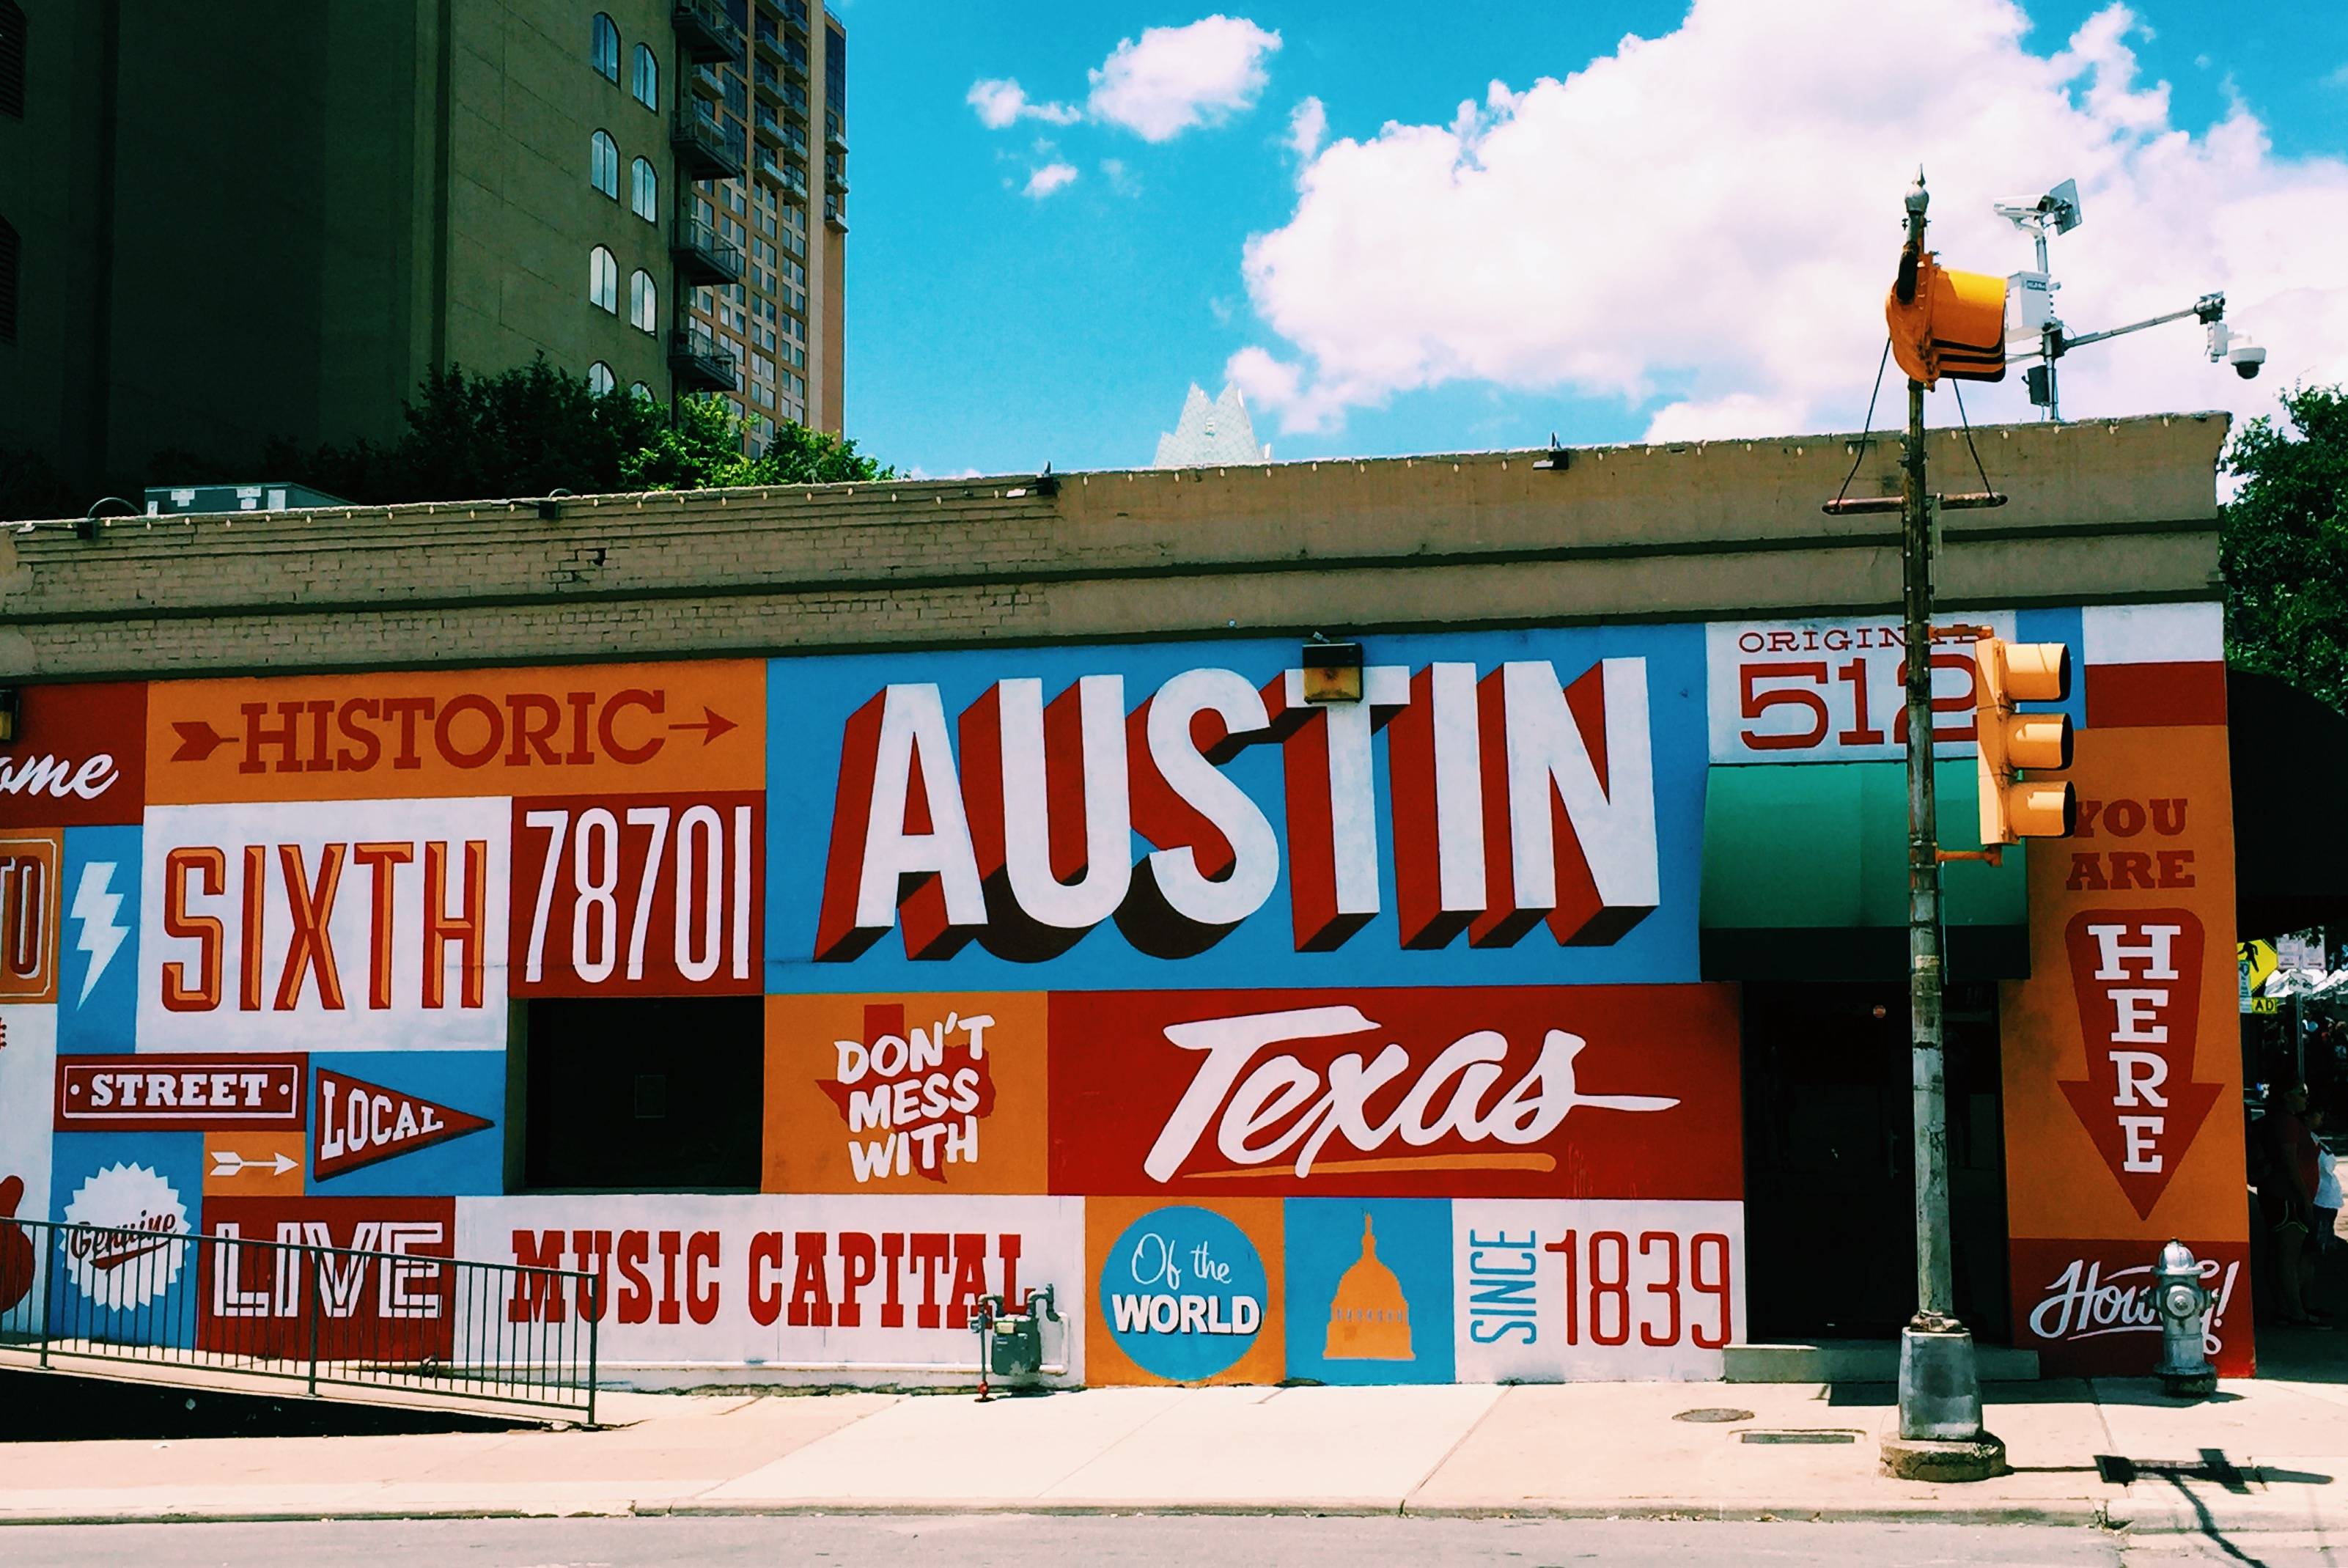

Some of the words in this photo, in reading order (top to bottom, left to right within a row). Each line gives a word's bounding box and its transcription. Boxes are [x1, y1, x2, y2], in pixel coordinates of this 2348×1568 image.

[1739, 624, 1978, 653] ORIGIN
[239, 688, 666, 774] HISTORIC
[1740, 654, 1978, 750] 512
[853, 655, 1660, 930] AUSTIN
[2075, 798, 2188, 839] YOU
[525, 805, 752, 984] 78701
[2066, 850, 2196, 891] ARE
[161, 840, 487, 1013] SIXTH
[90, 1072, 269, 1108] STREET
[833, 1012, 995, 1084] DON'T
[2087, 924, 2182, 1174] HERE
[320, 1081, 444, 1160] LOCAL
[849, 1067, 981, 1133] MESS
[1144, 1005, 1681, 1183] Texas
[847, 1115, 979, 1183] WITH
[213, 1221, 444, 1319] LIVE
[508, 1229, 721, 1325] MUSIC
[748, 1231, 1037, 1329] CAPITAL
[1130, 1232, 1182, 1290] Of
[1190, 1240, 1232, 1285] the
[1470, 1229, 1537, 1345] SINCE
[1544, 1229, 1732, 1350] 1839
[1111, 1293, 1263, 1336] WORLD
